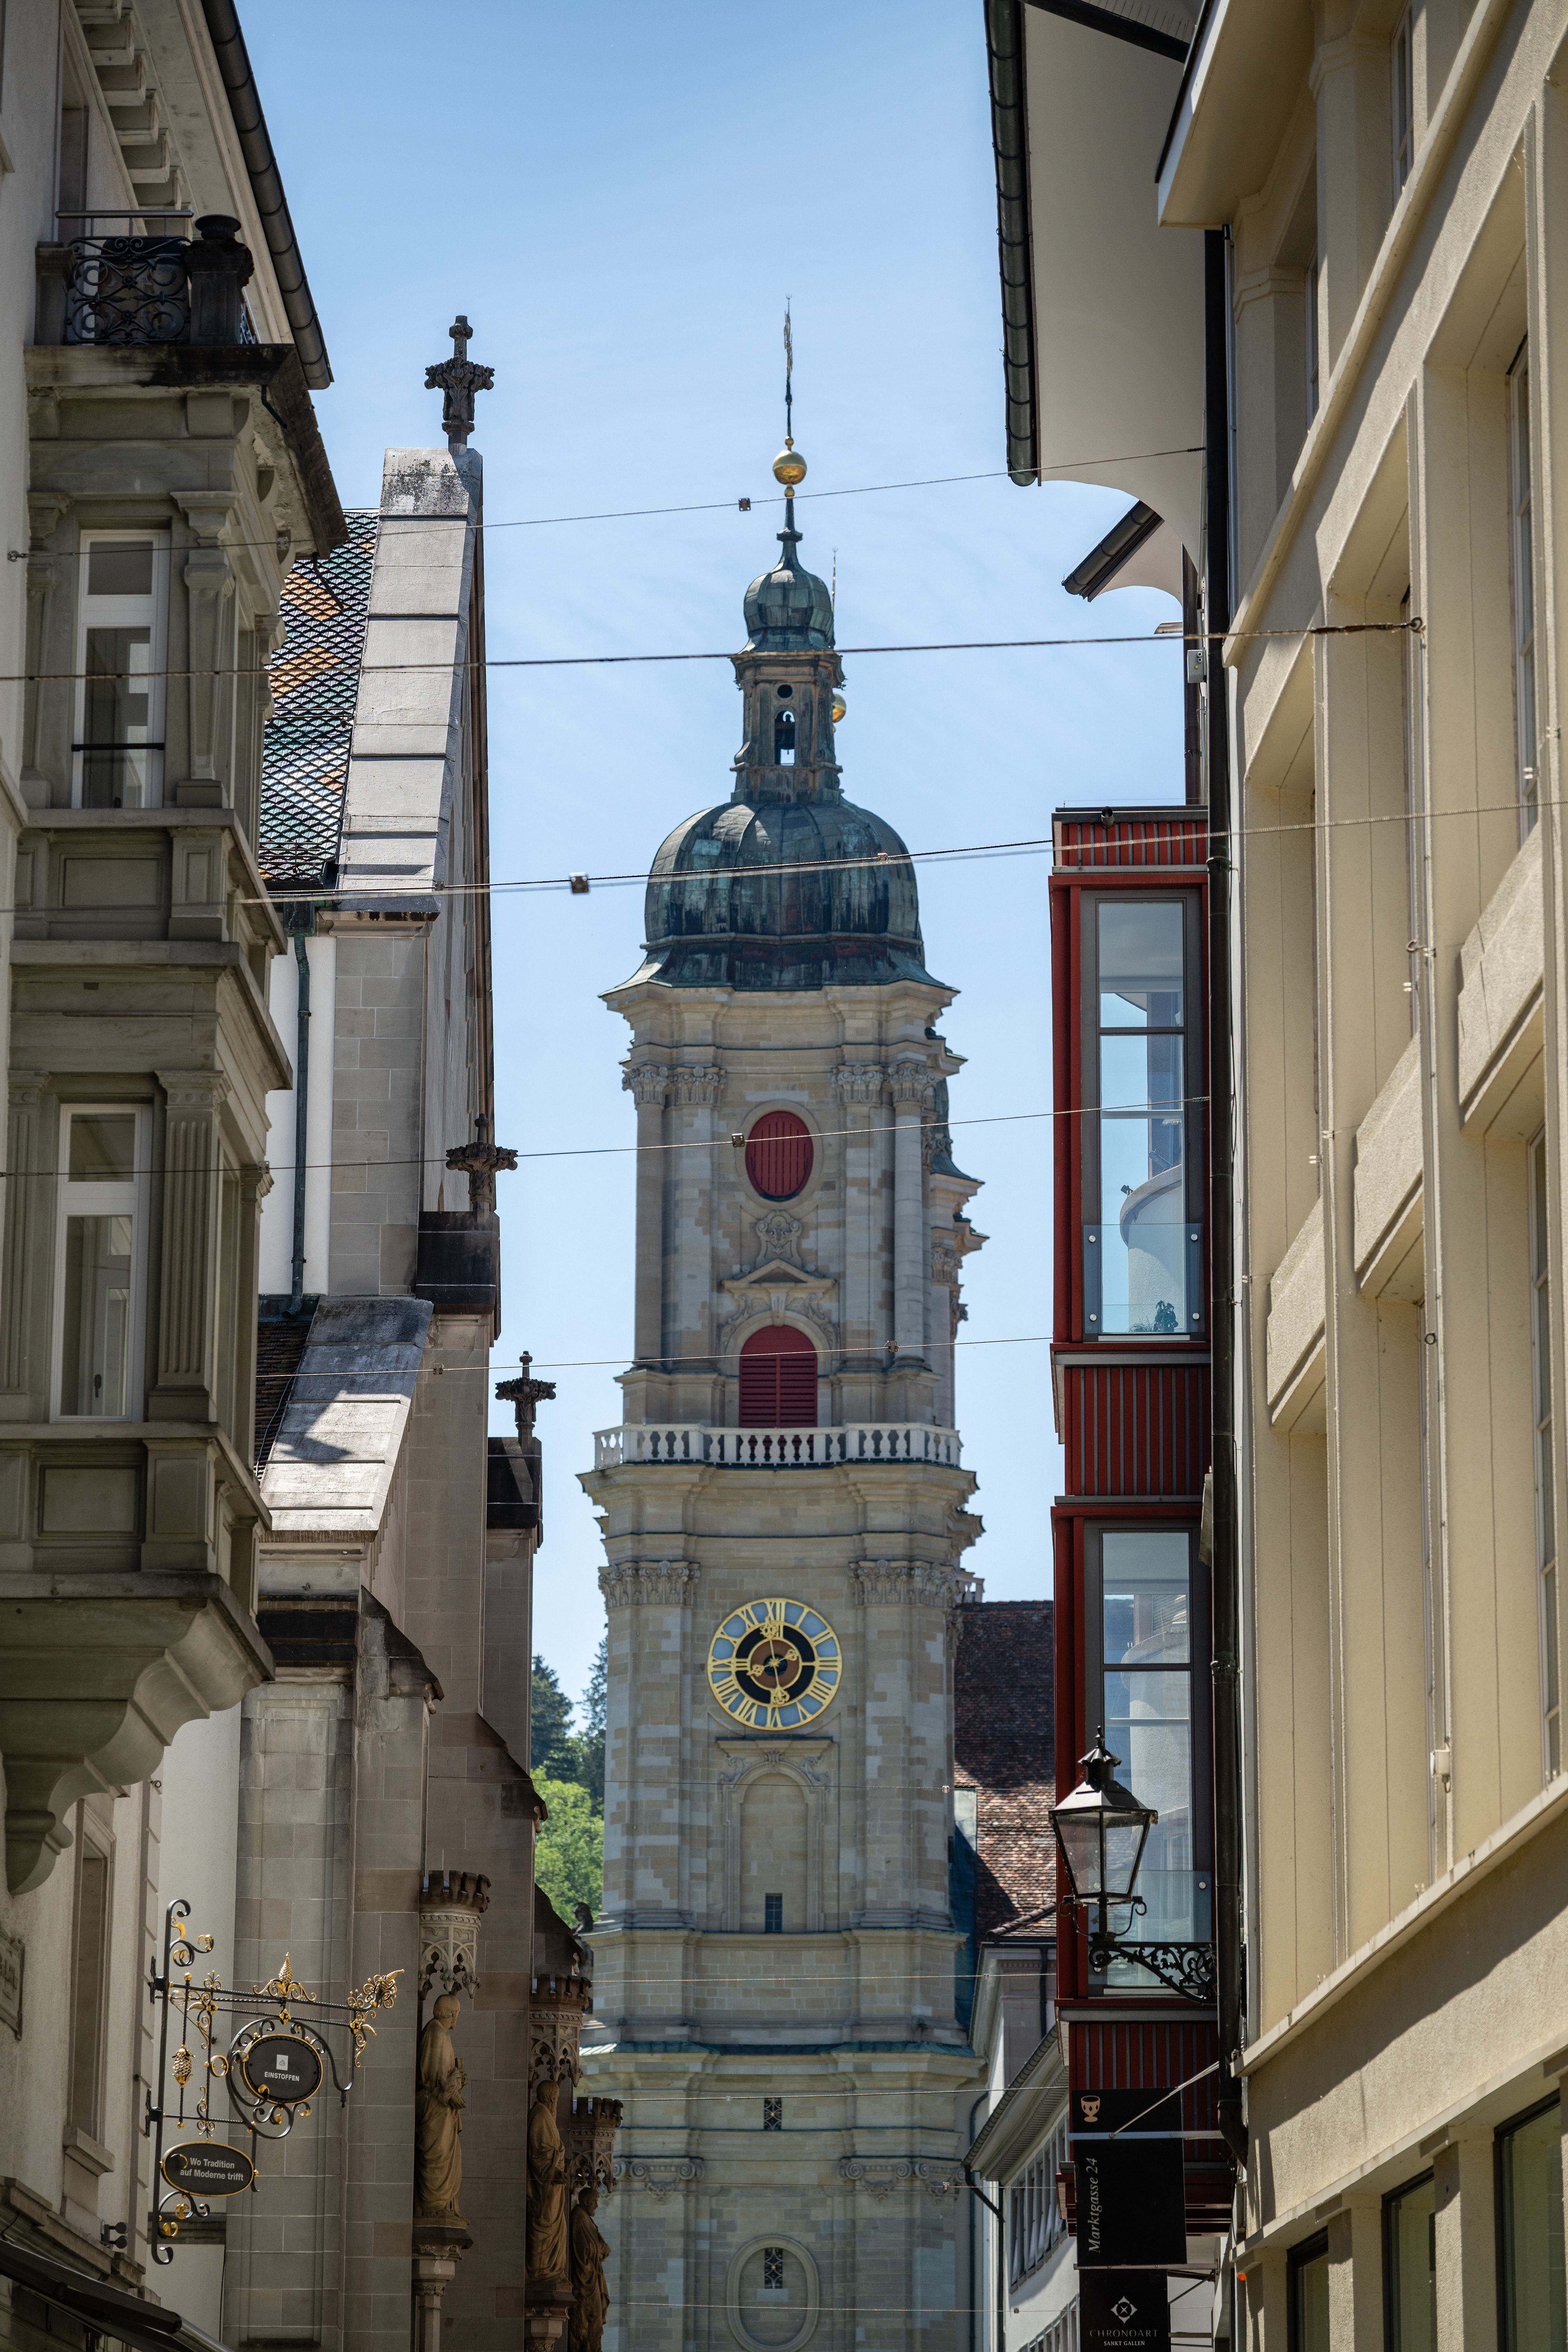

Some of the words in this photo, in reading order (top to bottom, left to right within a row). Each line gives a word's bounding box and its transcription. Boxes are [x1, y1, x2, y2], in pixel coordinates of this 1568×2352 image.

[765, 1601, 787, 1623] XII
[766, 1707, 783, 1728] VI
[264, 2071, 300, 2082] EINSTOFFEN
[190, 2157, 201, 2166] Wo
[203, 2158, 235, 2169] Tradition
[1086, 2157, 1098, 2174] 24
[194, 2170, 226, 2180] Moderne
[227, 2172, 244, 2181] trifft
[1088, 2177, 1102, 2253] Marktgasse
[1089, 2329, 1158, 2338] CHRONOART
